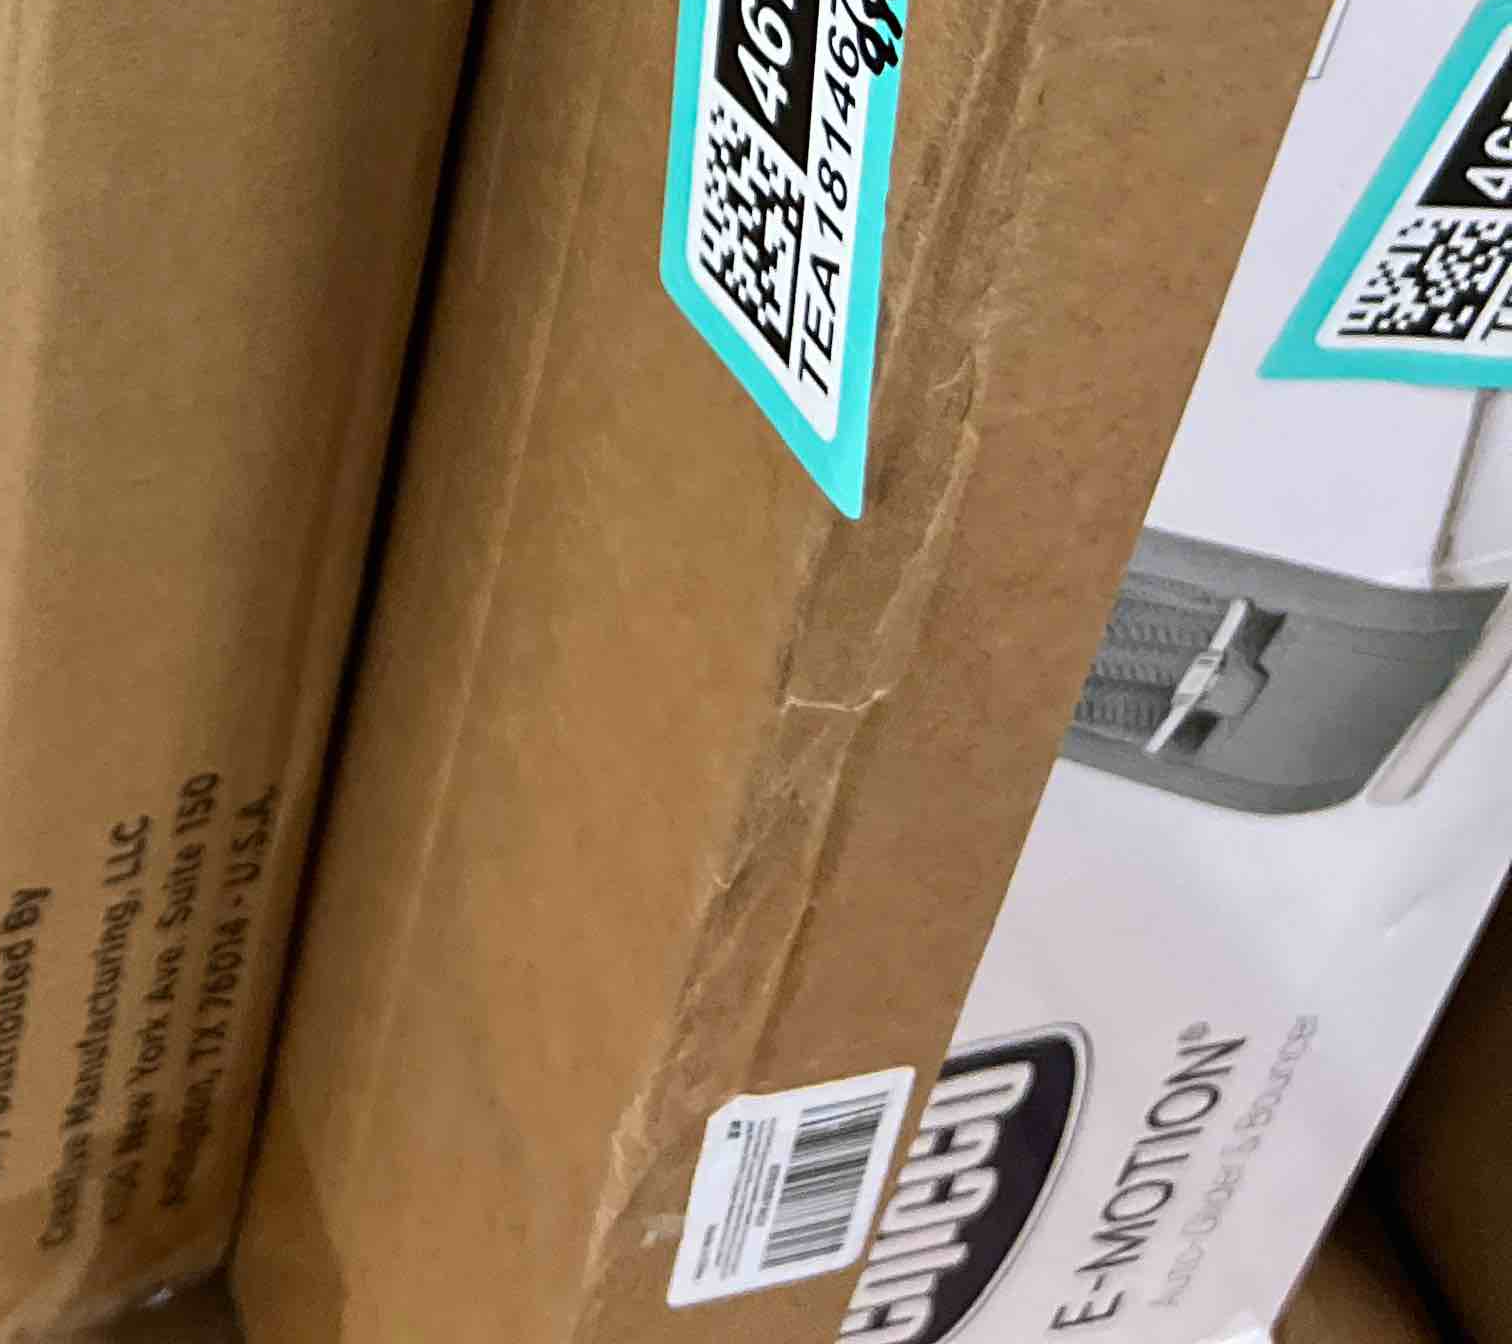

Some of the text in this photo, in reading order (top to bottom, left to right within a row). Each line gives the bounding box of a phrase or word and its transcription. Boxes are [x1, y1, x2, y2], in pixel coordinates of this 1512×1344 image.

[174, 772, 220, 837] 150
[225, 784, 280, 885] U.S.A.
[0, 885, 51, 936] By
[156, 842, 206, 932] Suite
[61, 889, 144, 1130] Manufacturing,
[103, 815, 149, 887] LLC
[200, 917, 250, 1017] 76014
[125, 1011, 170, 1088] York
[190, 1019, 228, 1063] TX
